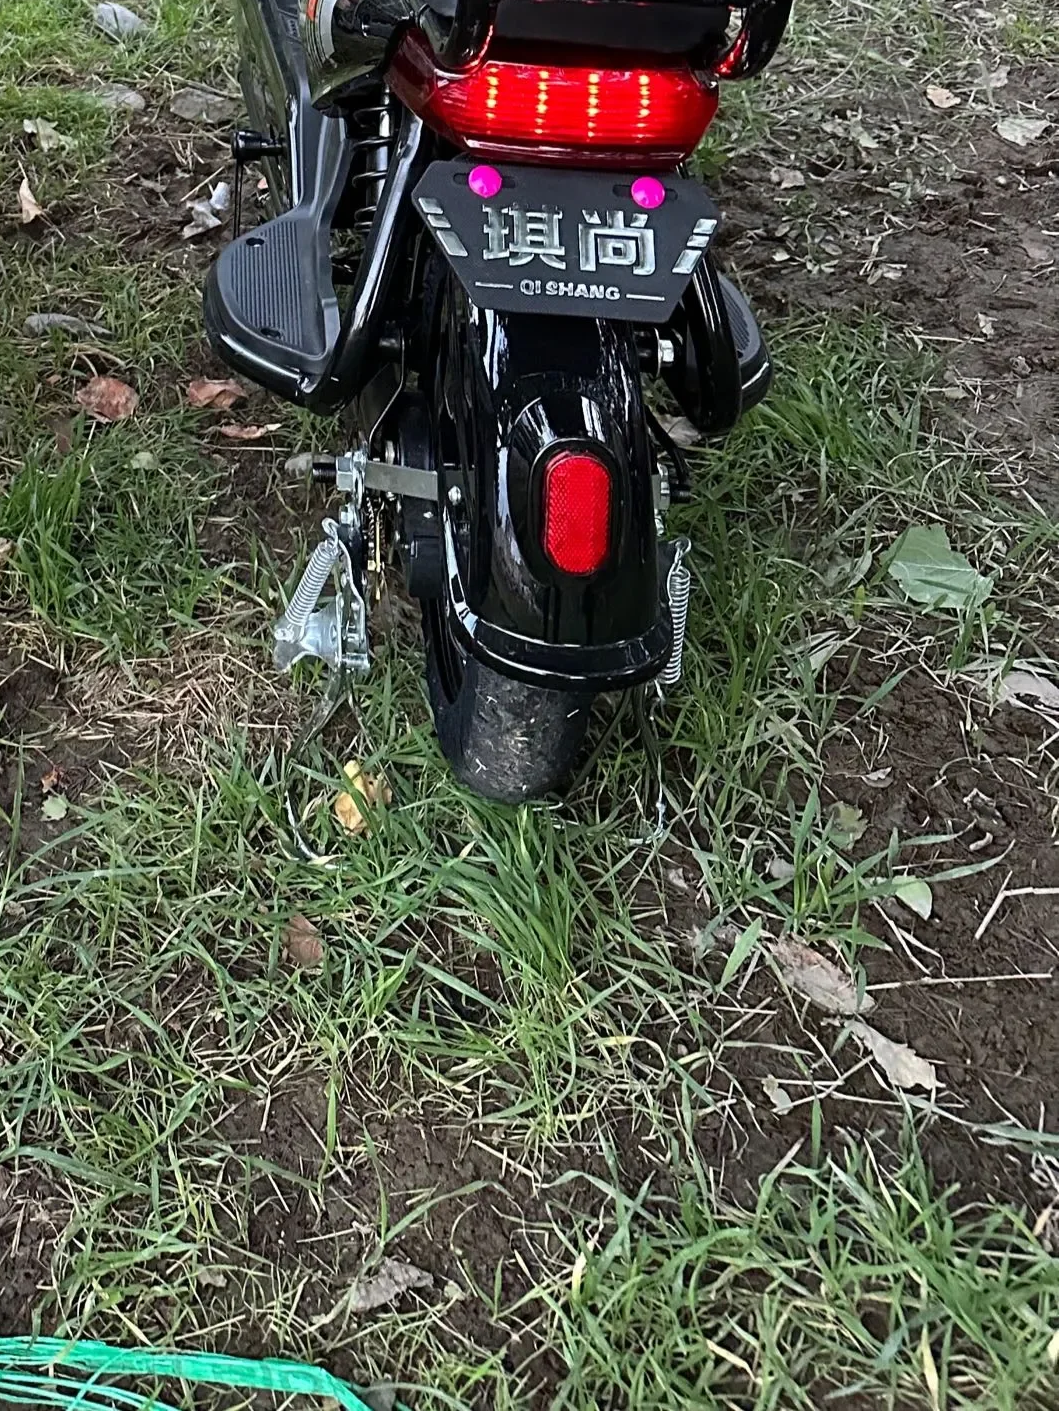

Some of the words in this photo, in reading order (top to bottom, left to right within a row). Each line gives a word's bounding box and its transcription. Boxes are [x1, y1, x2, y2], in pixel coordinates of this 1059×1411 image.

[482, 201, 656, 276] 琪尚
[519, 279, 542, 297] QI
[545, 281, 622, 301] SHANG
